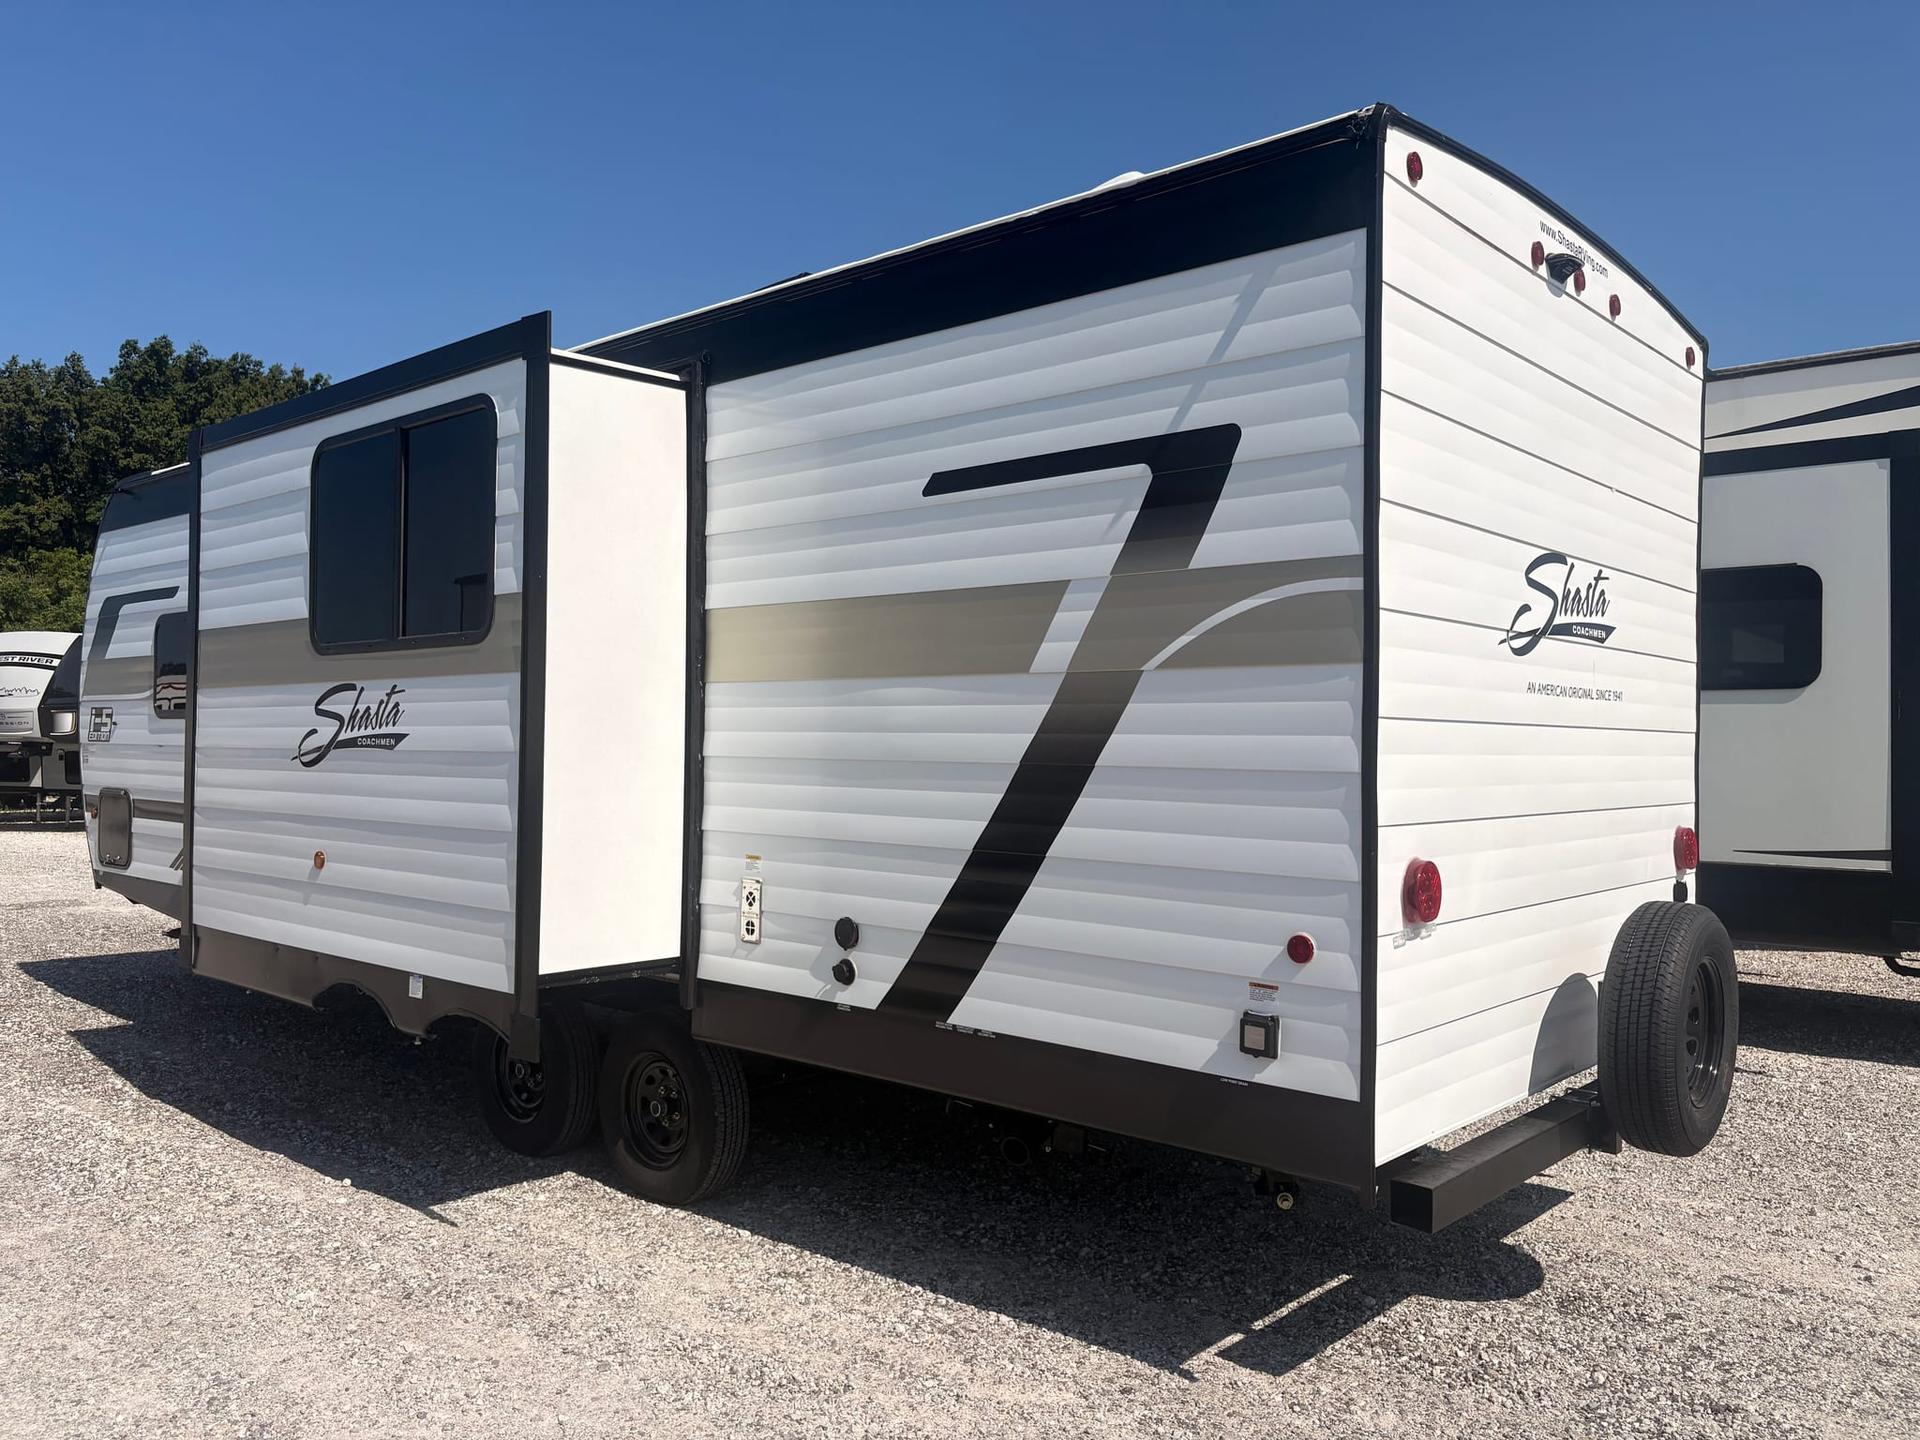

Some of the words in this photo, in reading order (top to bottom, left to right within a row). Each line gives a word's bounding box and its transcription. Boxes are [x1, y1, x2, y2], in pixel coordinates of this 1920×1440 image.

[1539, 219, 1609, 279] www.ShastaRVing.com
[1498, 552, 1611, 657] Shasta
[1572, 624, 1606, 639] COACHMEN
[18, 656, 54, 665] RIVER
[1526, 681, 1537, 694] AN
[1537, 682, 1568, 697] AMERICAN
[1568, 686, 1594, 700] ORIGINAL
[1595, 688, 1612, 701] SINCE
[291, 682, 406, 768] Shasta
[357, 738, 396, 746] COACHMEN
